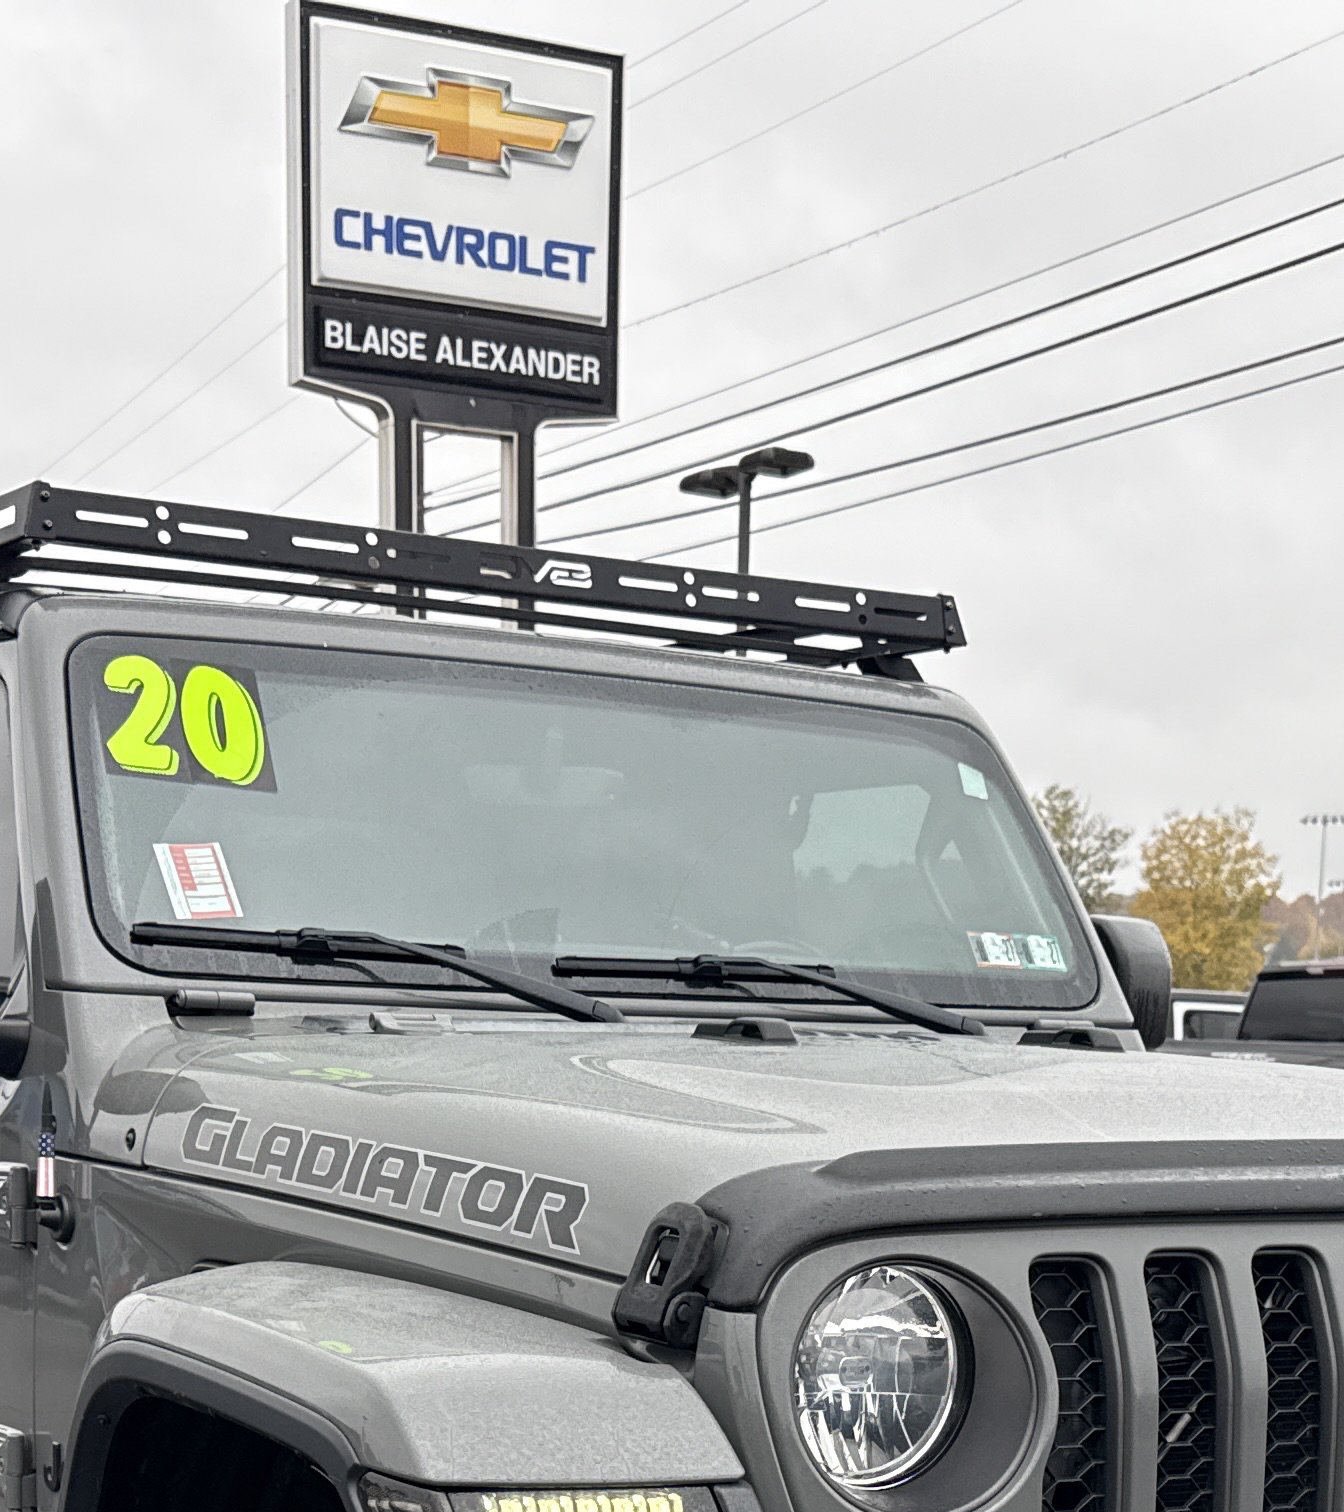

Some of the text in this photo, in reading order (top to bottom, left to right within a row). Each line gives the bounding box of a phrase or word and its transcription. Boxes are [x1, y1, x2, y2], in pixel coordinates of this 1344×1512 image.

[334, 207, 596, 283] CHEVROLET
[324, 319, 601, 386] BLAISE ALEXANDER
[102, 654, 265, 787] 20
[180, 1102, 590, 1255] GLADIATOR
